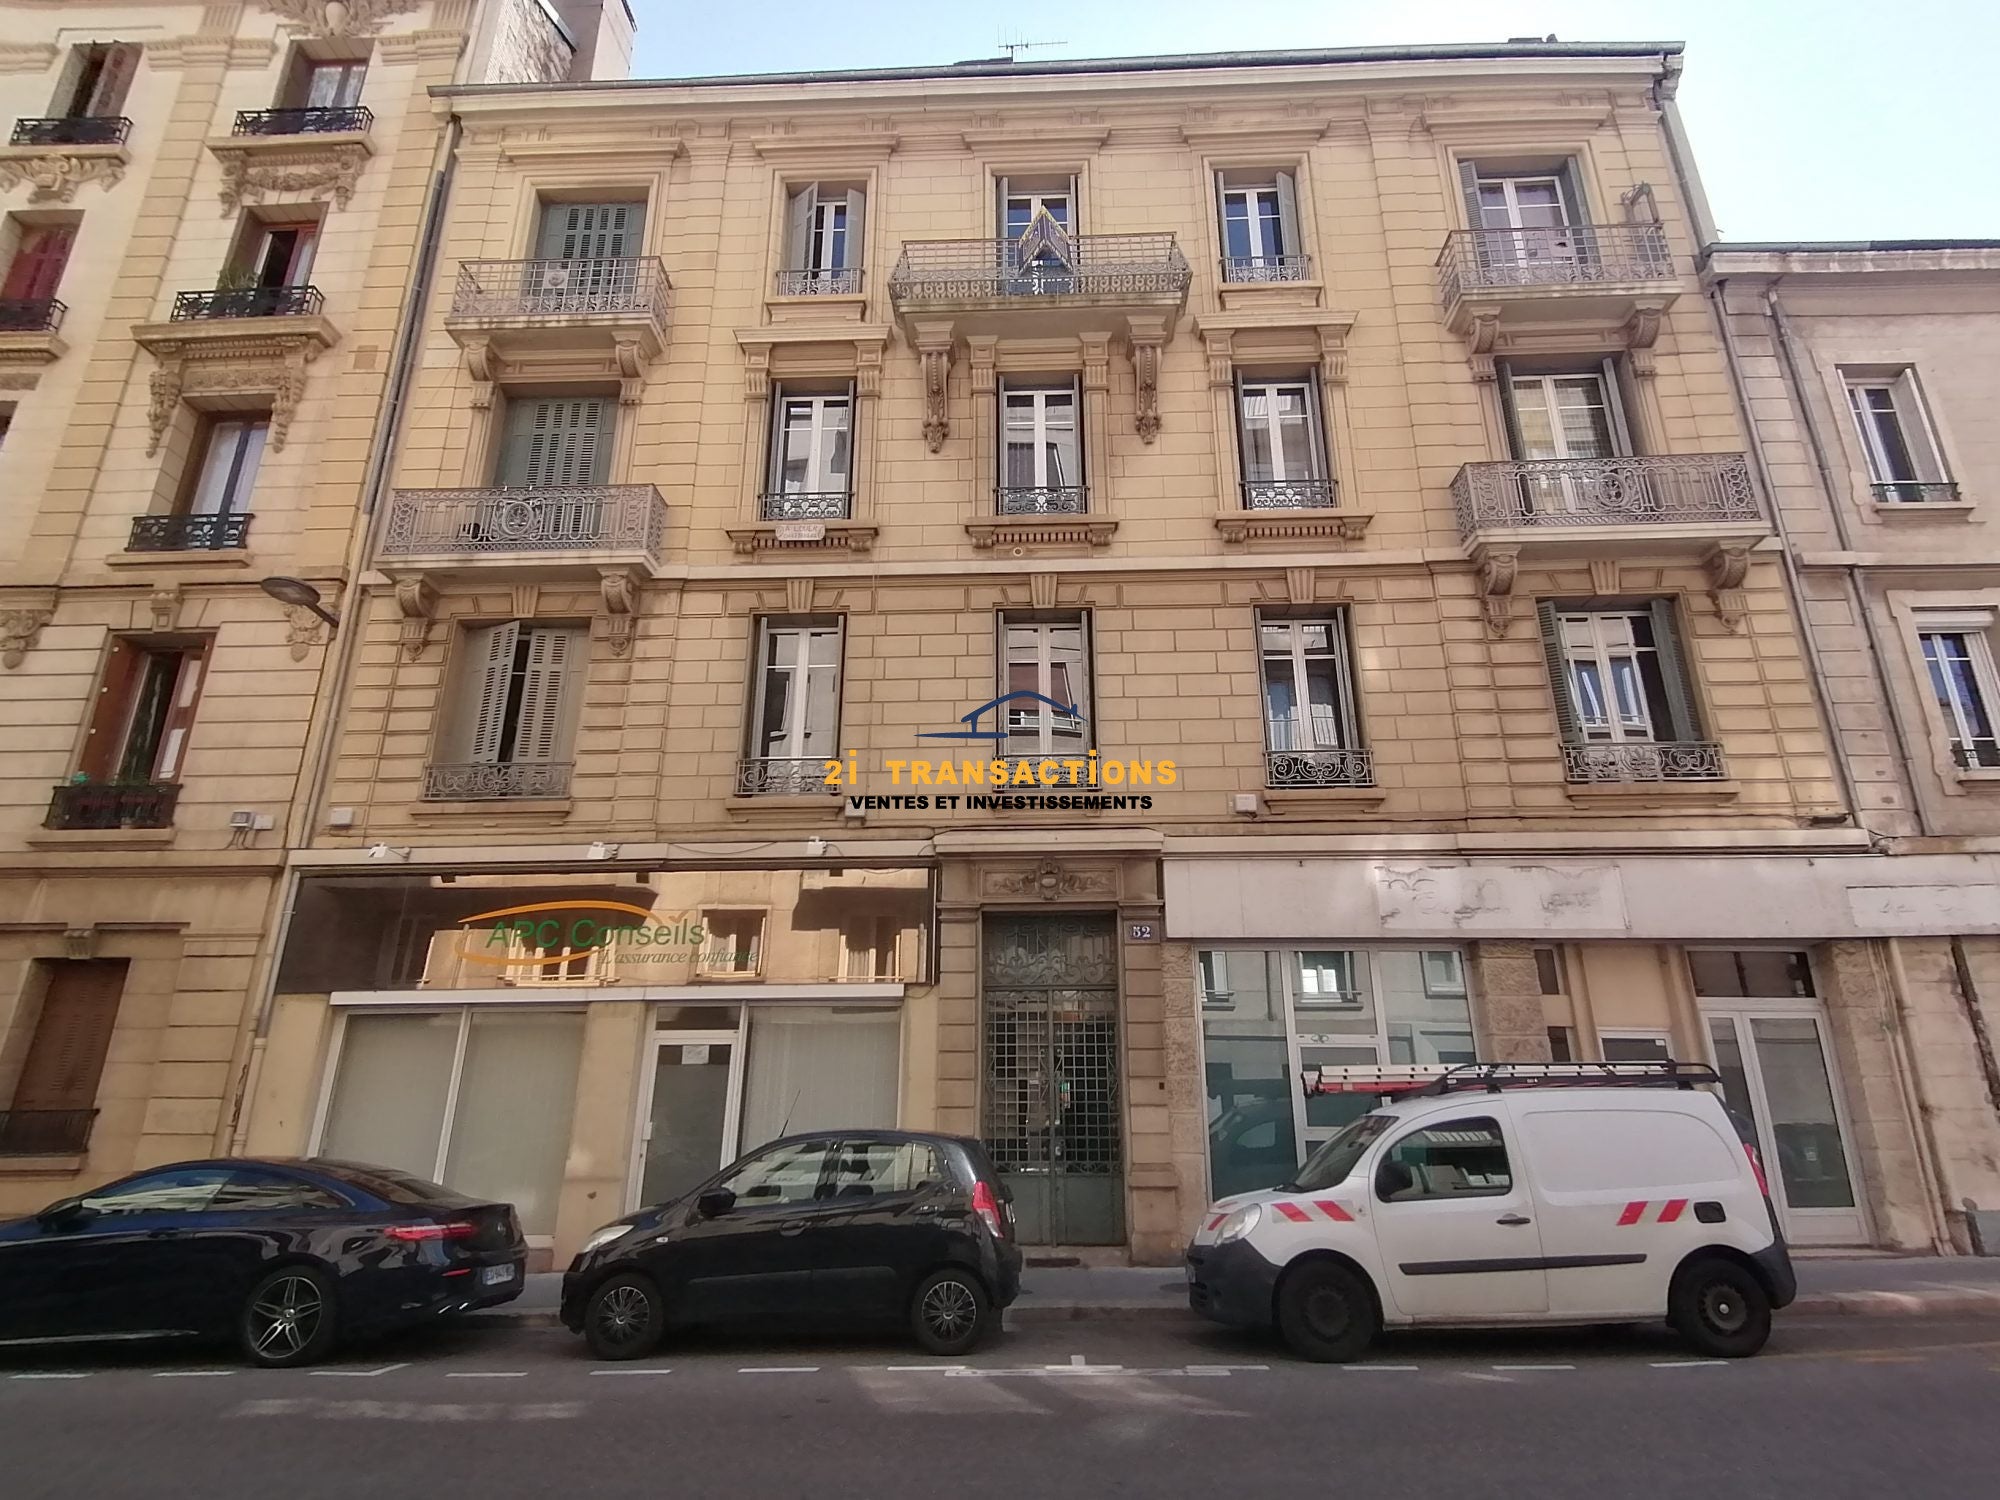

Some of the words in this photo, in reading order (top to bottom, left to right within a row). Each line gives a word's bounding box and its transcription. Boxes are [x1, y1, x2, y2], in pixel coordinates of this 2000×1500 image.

[486, 920, 558, 948] APC
[571, 918, 705, 948] Conseils
[1133, 926, 1151, 938] 52
[601, 949, 687, 964] L'assurance
